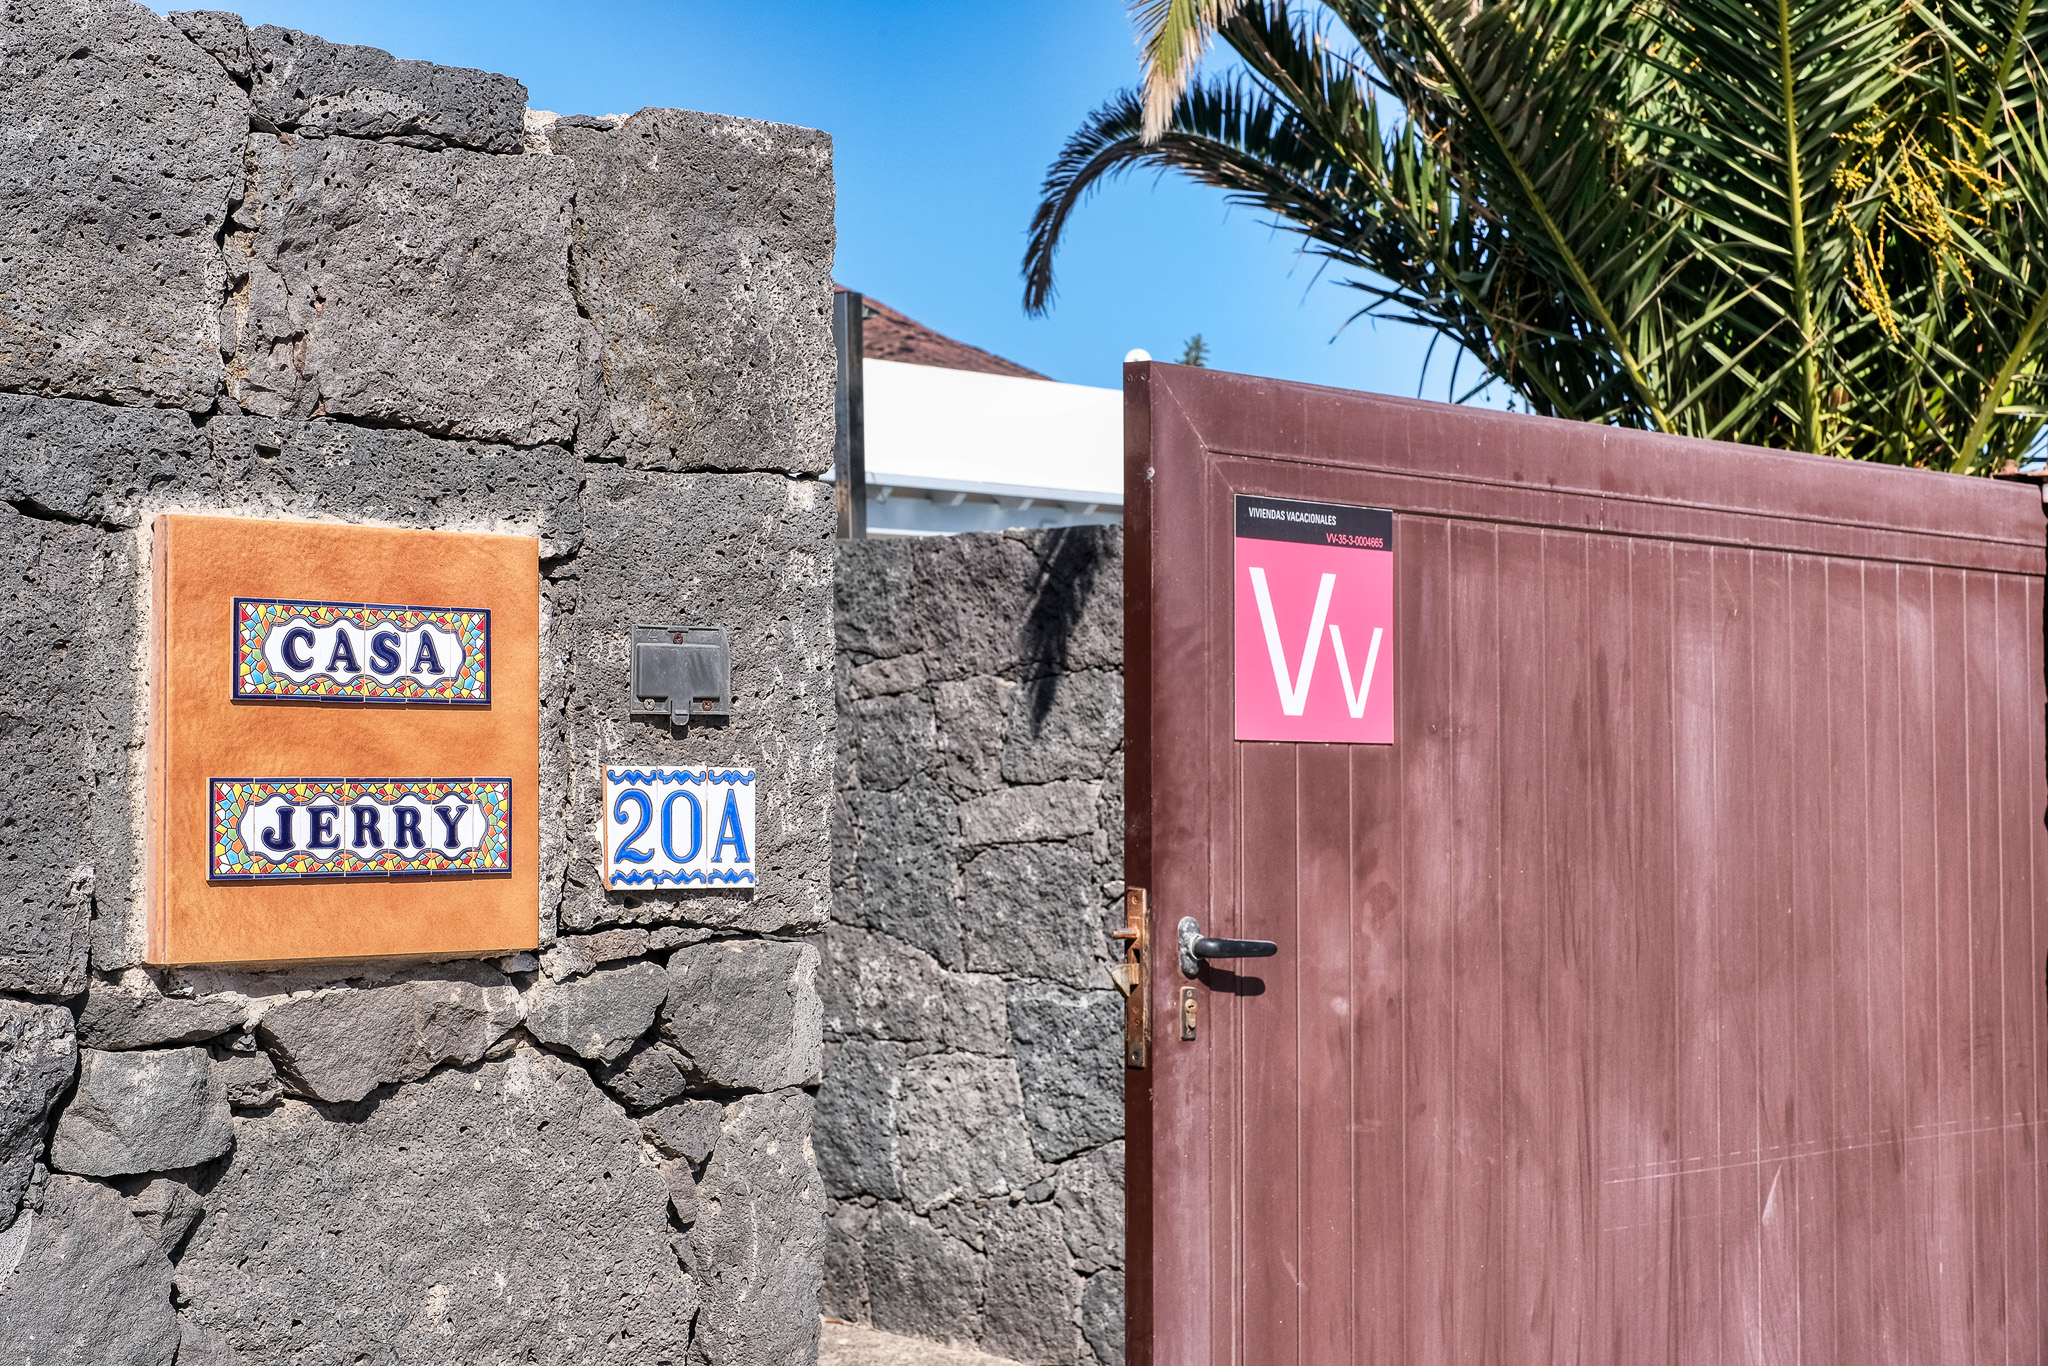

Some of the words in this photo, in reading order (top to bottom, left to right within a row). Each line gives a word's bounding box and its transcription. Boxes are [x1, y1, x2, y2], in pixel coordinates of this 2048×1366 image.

[1248, 506, 1285, 521] VIVIENDAS
[1286, 511, 1337, 526] VACACIONALES
[281, 627, 445, 675] CASA
[261, 805, 468, 851] JERRY
[613, 788, 751, 864] 20A
